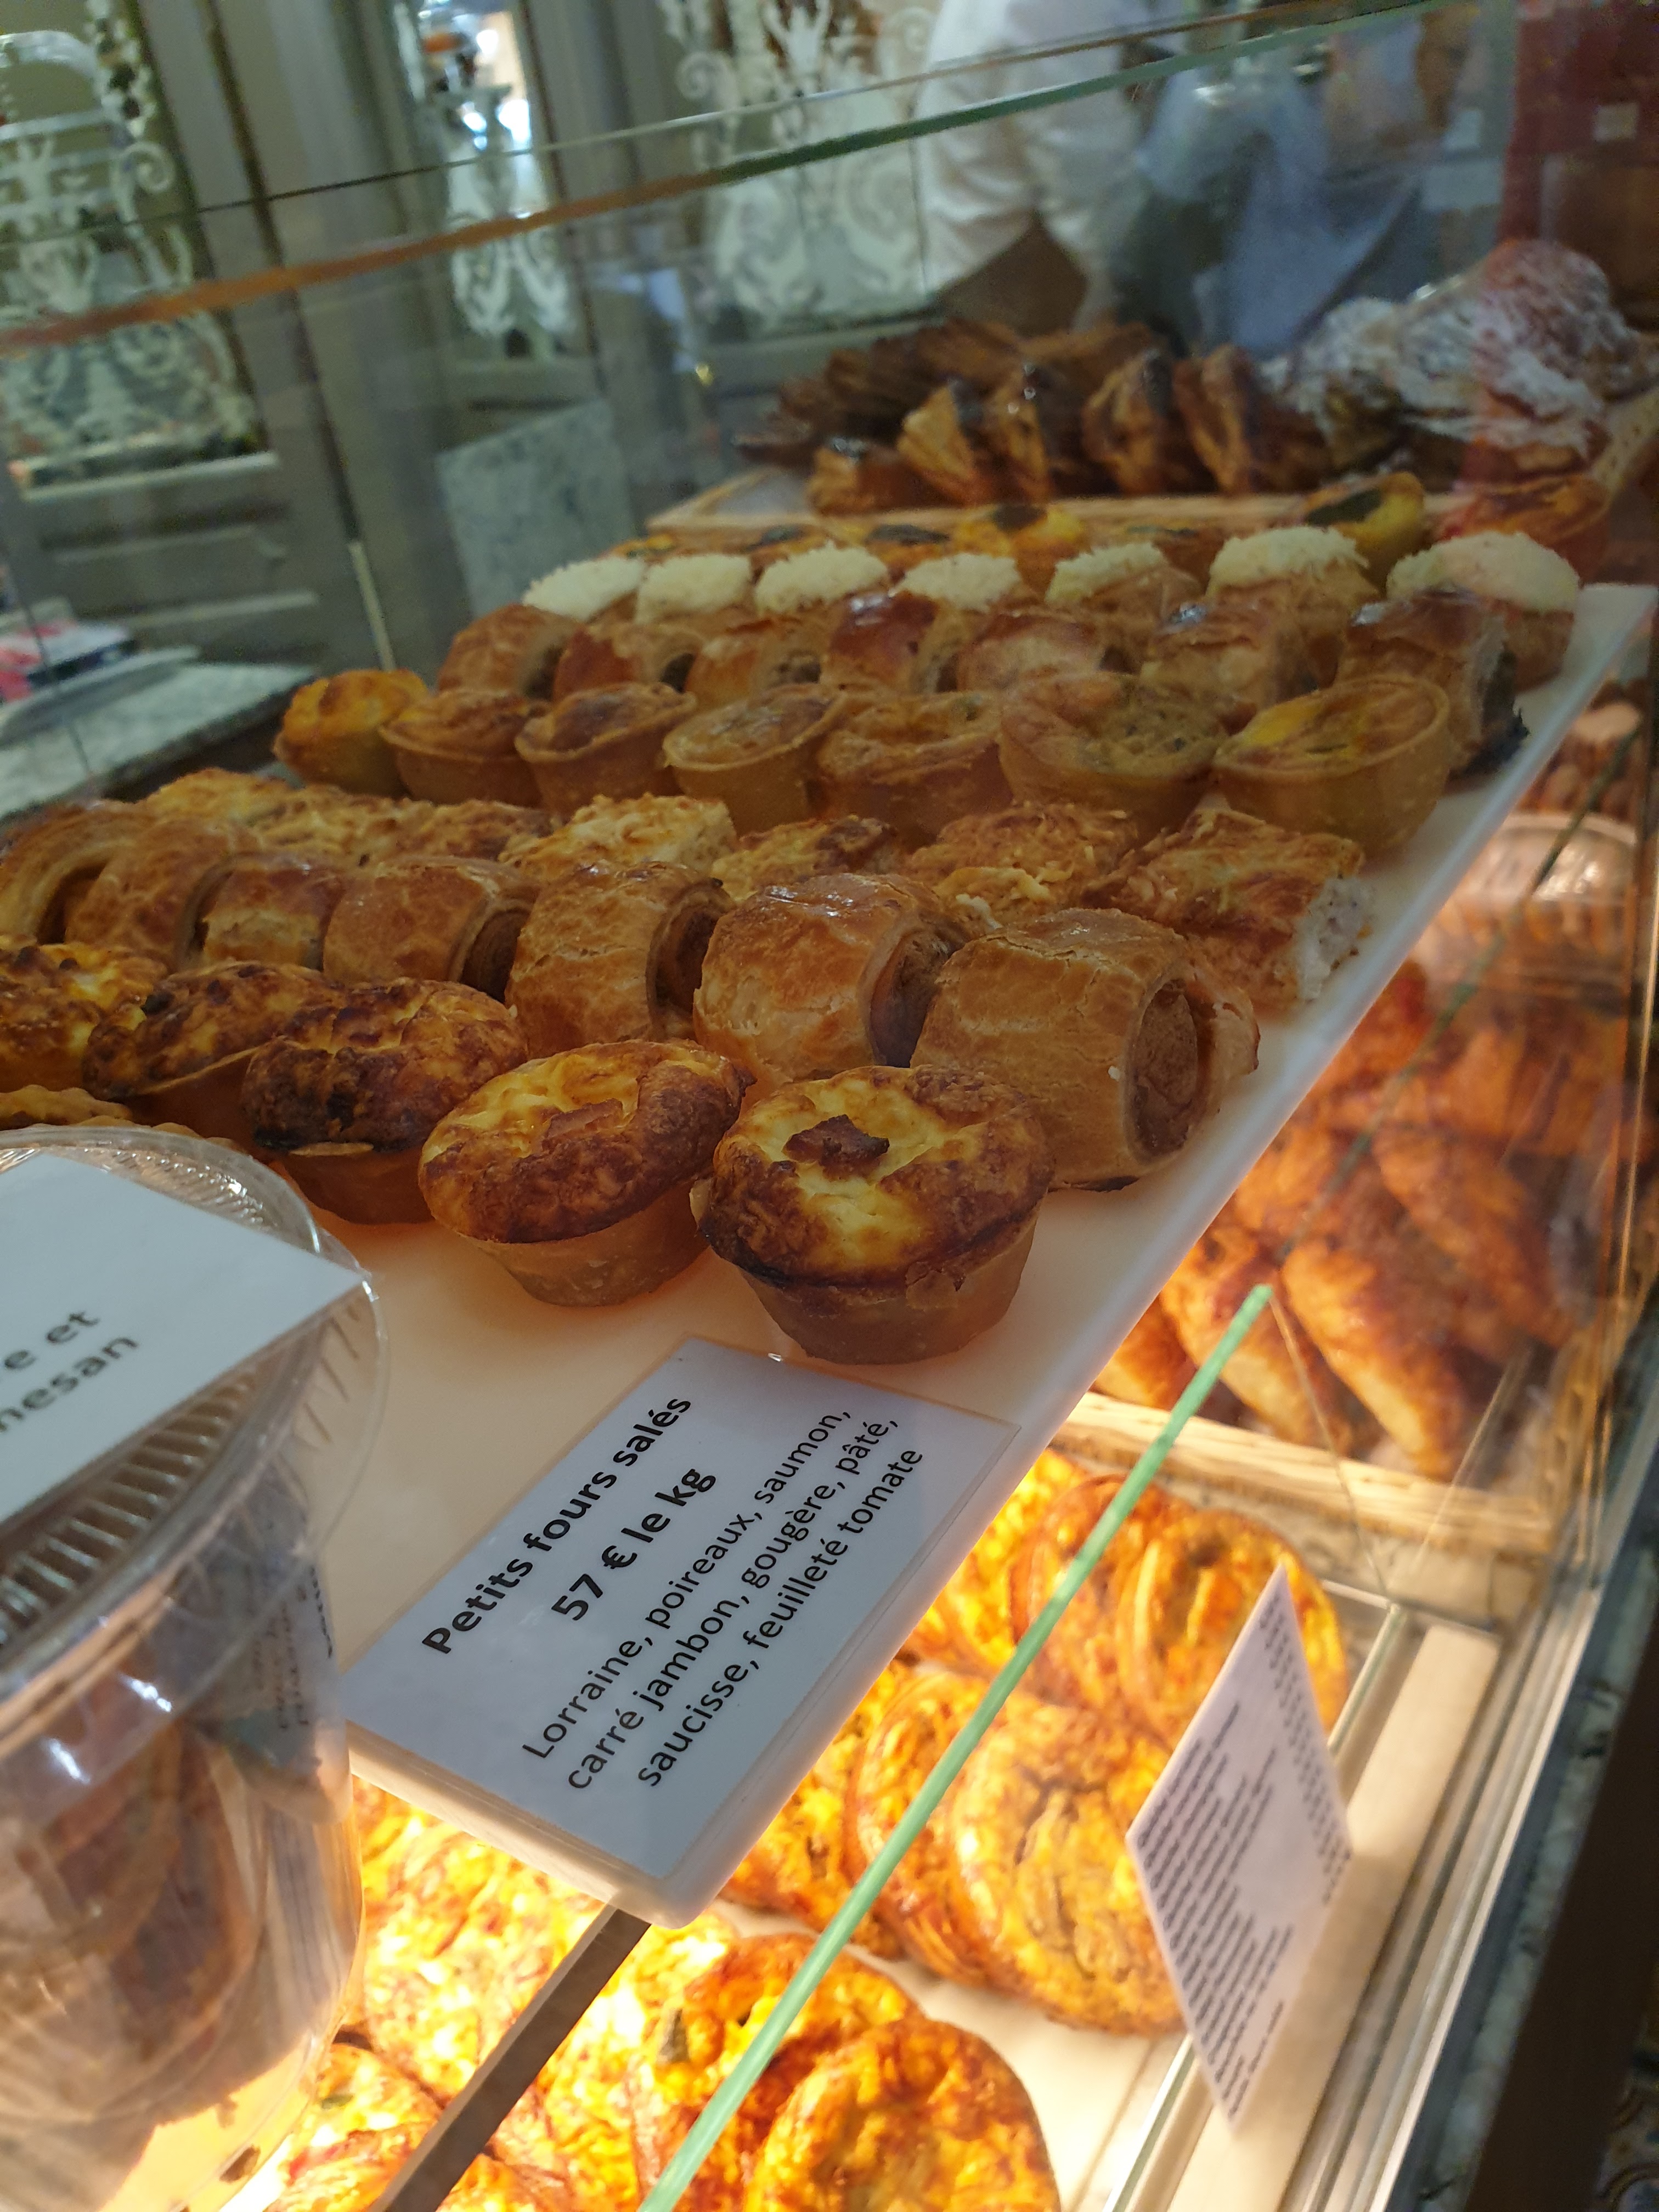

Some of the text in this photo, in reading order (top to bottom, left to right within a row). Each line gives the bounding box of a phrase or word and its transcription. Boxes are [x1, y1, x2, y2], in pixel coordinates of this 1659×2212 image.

[44, 1312, 100, 1345] et
[422, 1396, 691, 1654] Petits fours salés
[522, 1412, 850, 1758] Lorraine, poireaux, saumon,
[551, 1469, 716, 1621] 57 € le kg
[568, 1421, 898, 1788] carré jambon, gougère, pâté,
[638, 1451, 922, 1787] saucisse, feuilleté tomate
